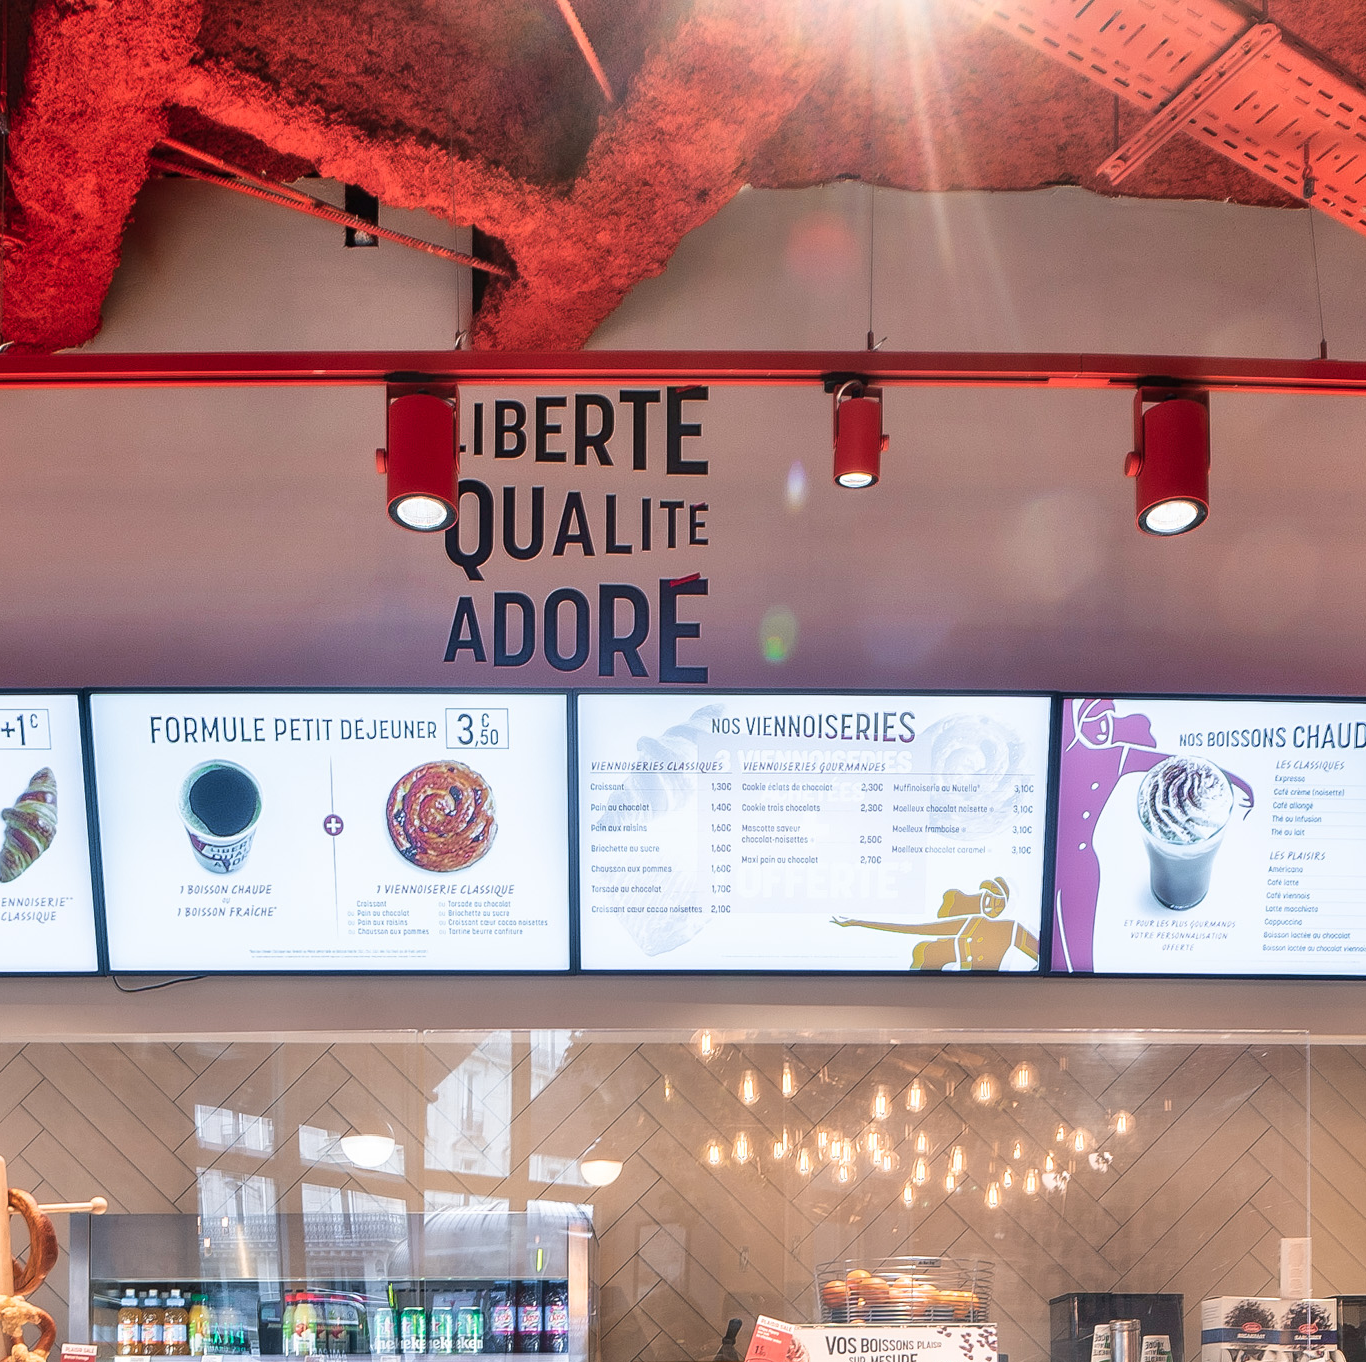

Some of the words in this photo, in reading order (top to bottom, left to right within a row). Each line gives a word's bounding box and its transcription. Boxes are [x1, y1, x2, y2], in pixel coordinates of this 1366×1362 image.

[459, 385, 709, 475] IBERTÉ
[445, 479, 709, 580] QUALITÉ
[443, 572, 709, 683] ADORÉ
[150, 716, 265, 744] FORMULE
[274, 718, 333, 742] PETIT
[340, 716, 437, 740] DÉJEUNER
[711, 716, 741, 735] NOS
[747, 711, 916, 743] VIENNOISERIES
[1179, 732, 1203, 747] NOS
[1207, 727, 1287, 748] BOISSONS
[591, 762, 664, 771] VIENNOISERIES
[667, 762, 723, 773] CLASSIQUES
[743, 762, 816, 771] VIENNOISERIES
[819, 762, 886, 773] GOURMANDES
[1276, 760, 1291, 770] LES
[1293, 760, 1345, 772] CLASSIQUES
[590, 783, 625, 791] Croissant
[742, 783, 766, 791] Cookie
[742, 804, 766, 812] Cookie
[1270, 851, 1285, 860] LES
[1287, 851, 1326, 861] PLAISIRS
[179, 885, 184, 895] 1
[187, 884, 229, 894] BOISSON
[232, 884, 272, 894] CHAUDE
[377, 885, 381, 894] 1
[384, 884, 457, 894] VIENNOISERIE
[460, 884, 515, 897] CLASSIQUE
[1, 911, 57, 923] CLASSIQUE
[177, 907, 182, 917] 1
[185, 907, 227, 917] BOISSON
[825, 1336, 857, 1355] VOS
[861, 1338, 914, 1353] BOISSONS
